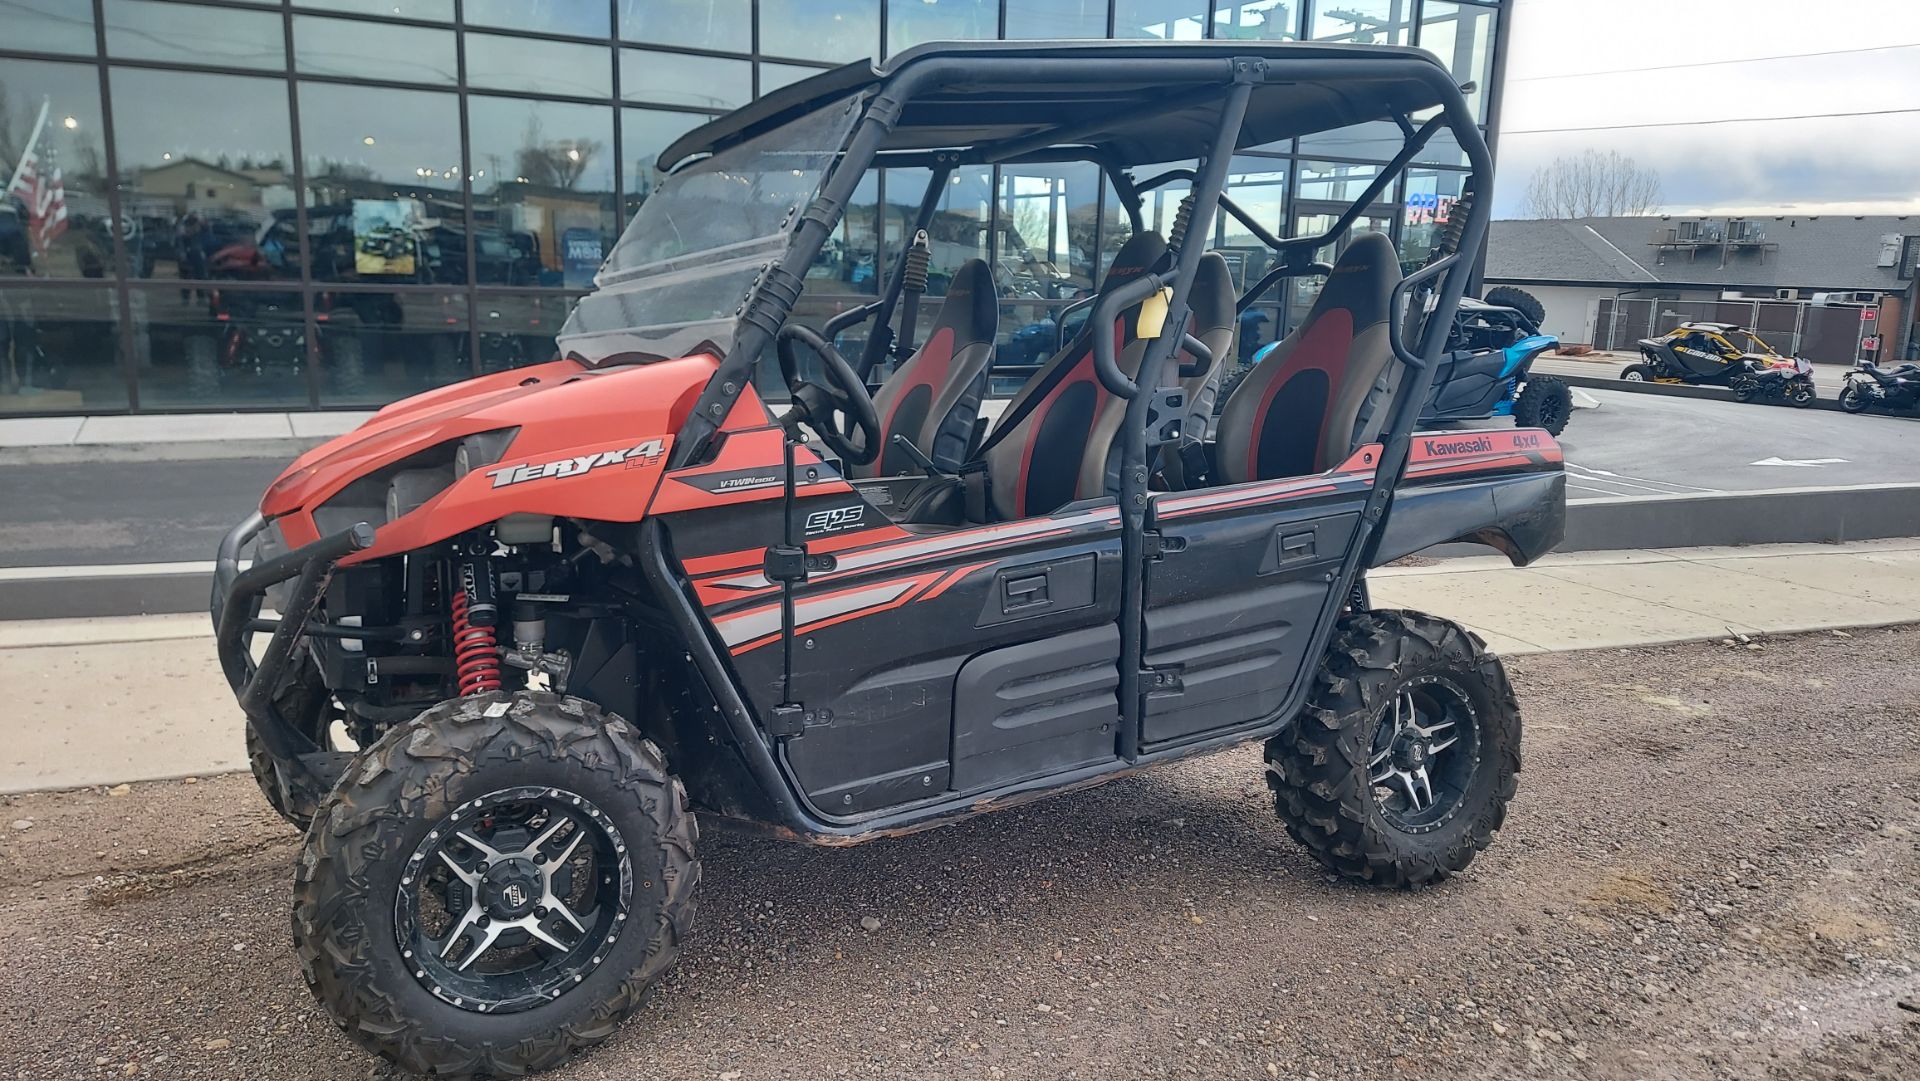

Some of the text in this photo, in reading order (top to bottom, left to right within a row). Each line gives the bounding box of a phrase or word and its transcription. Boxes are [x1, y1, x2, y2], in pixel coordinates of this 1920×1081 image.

[1405, 193, 1460, 225] OPE
[1424, 436, 1493, 456] Kawasaki
[1513, 434, 1539, 449] 4x4
[805, 505, 864, 529] EPS
[463, 562, 477, 601] FOX
[511, 884, 519, 908] TUSK
